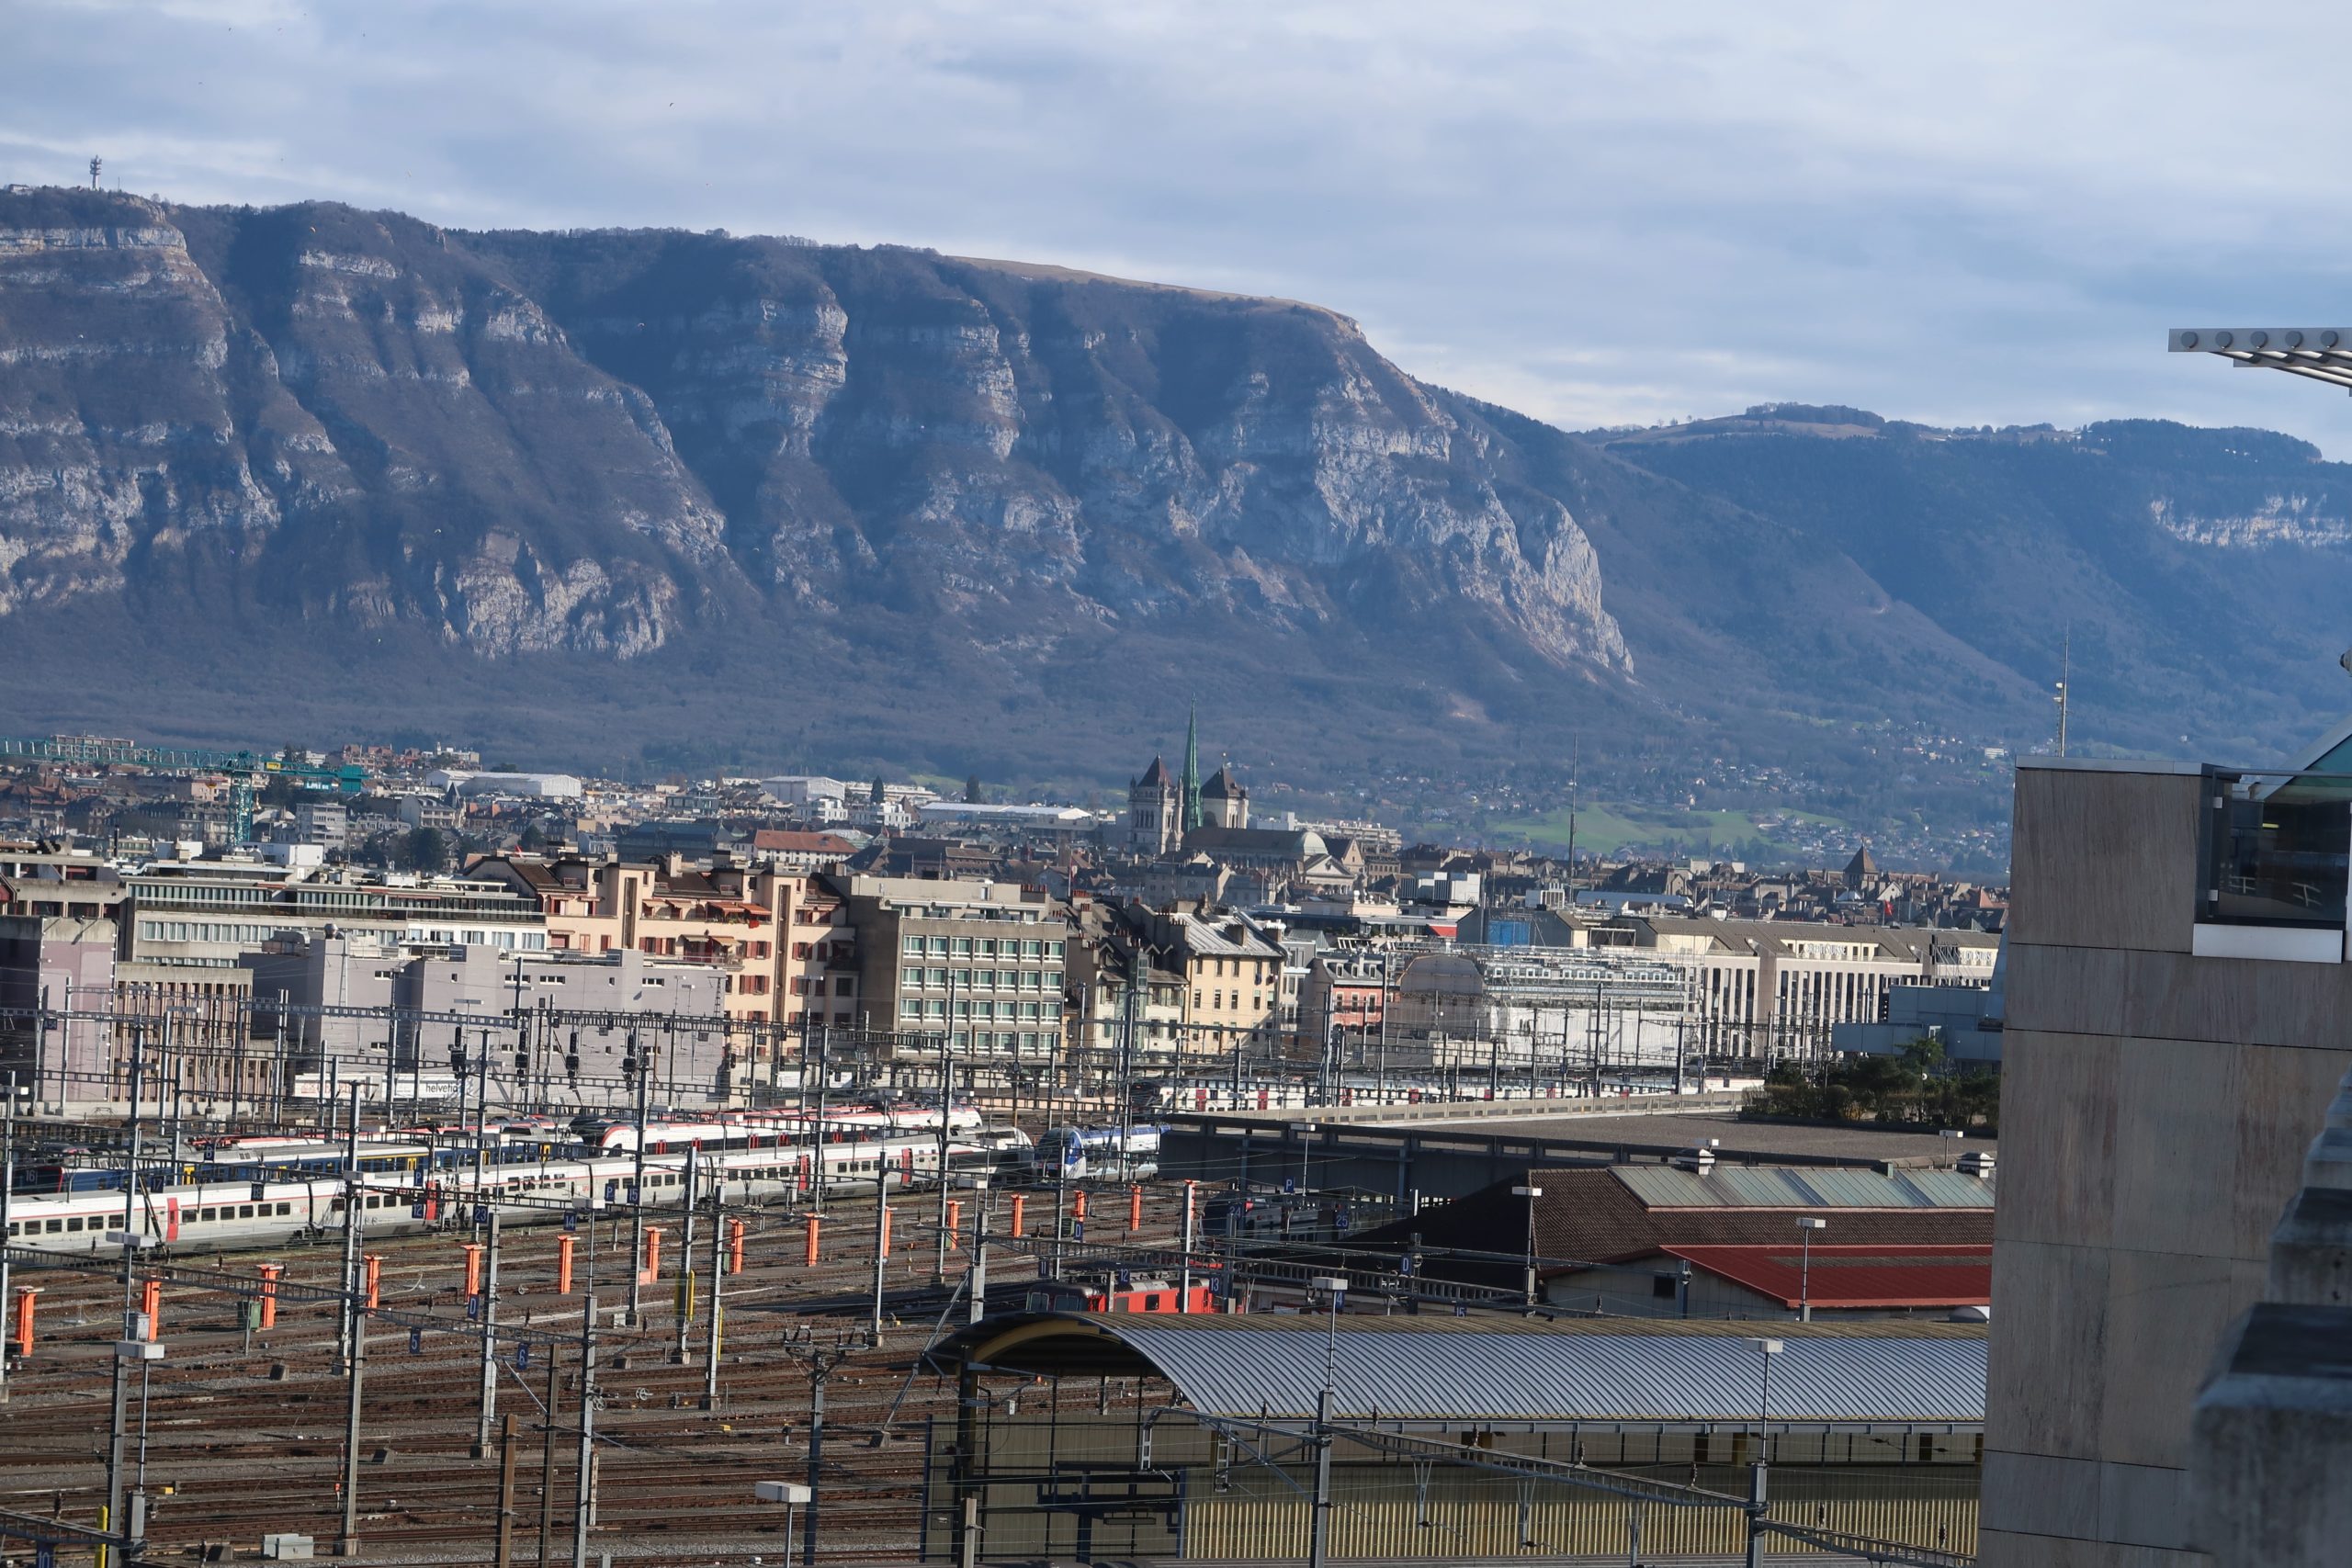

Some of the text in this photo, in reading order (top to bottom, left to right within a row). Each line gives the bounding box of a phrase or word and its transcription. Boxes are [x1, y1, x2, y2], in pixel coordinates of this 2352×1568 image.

[425, 1082, 458, 1092] helvetia
[26, 1169, 35, 1182] 16
[415, 1172, 422, 1184] P
[153, 1179, 163, 1191] 17
[1285, 1179, 1292, 1191] P
[606, 1186, 613, 1199] P
[629, 1189, 639, 1201] 15
[413, 1204, 422, 1216] 12
[474, 1208, 487, 1221] 23
[1229, 1206, 1241, 1220] 24
[566, 1215, 574, 1228] 14
[1336, 1215, 1348, 1227] 25
[1075, 1224, 1081, 1237] D
[1402, 1258, 1409, 1272] D
[1120, 1269, 1128, 1282] 12
[1211, 1278, 1219, 1292] 13
[469, 1298, 477, 1314] D
[412, 1334, 418, 1349] 5
[518, 1349, 526, 1366] 6
